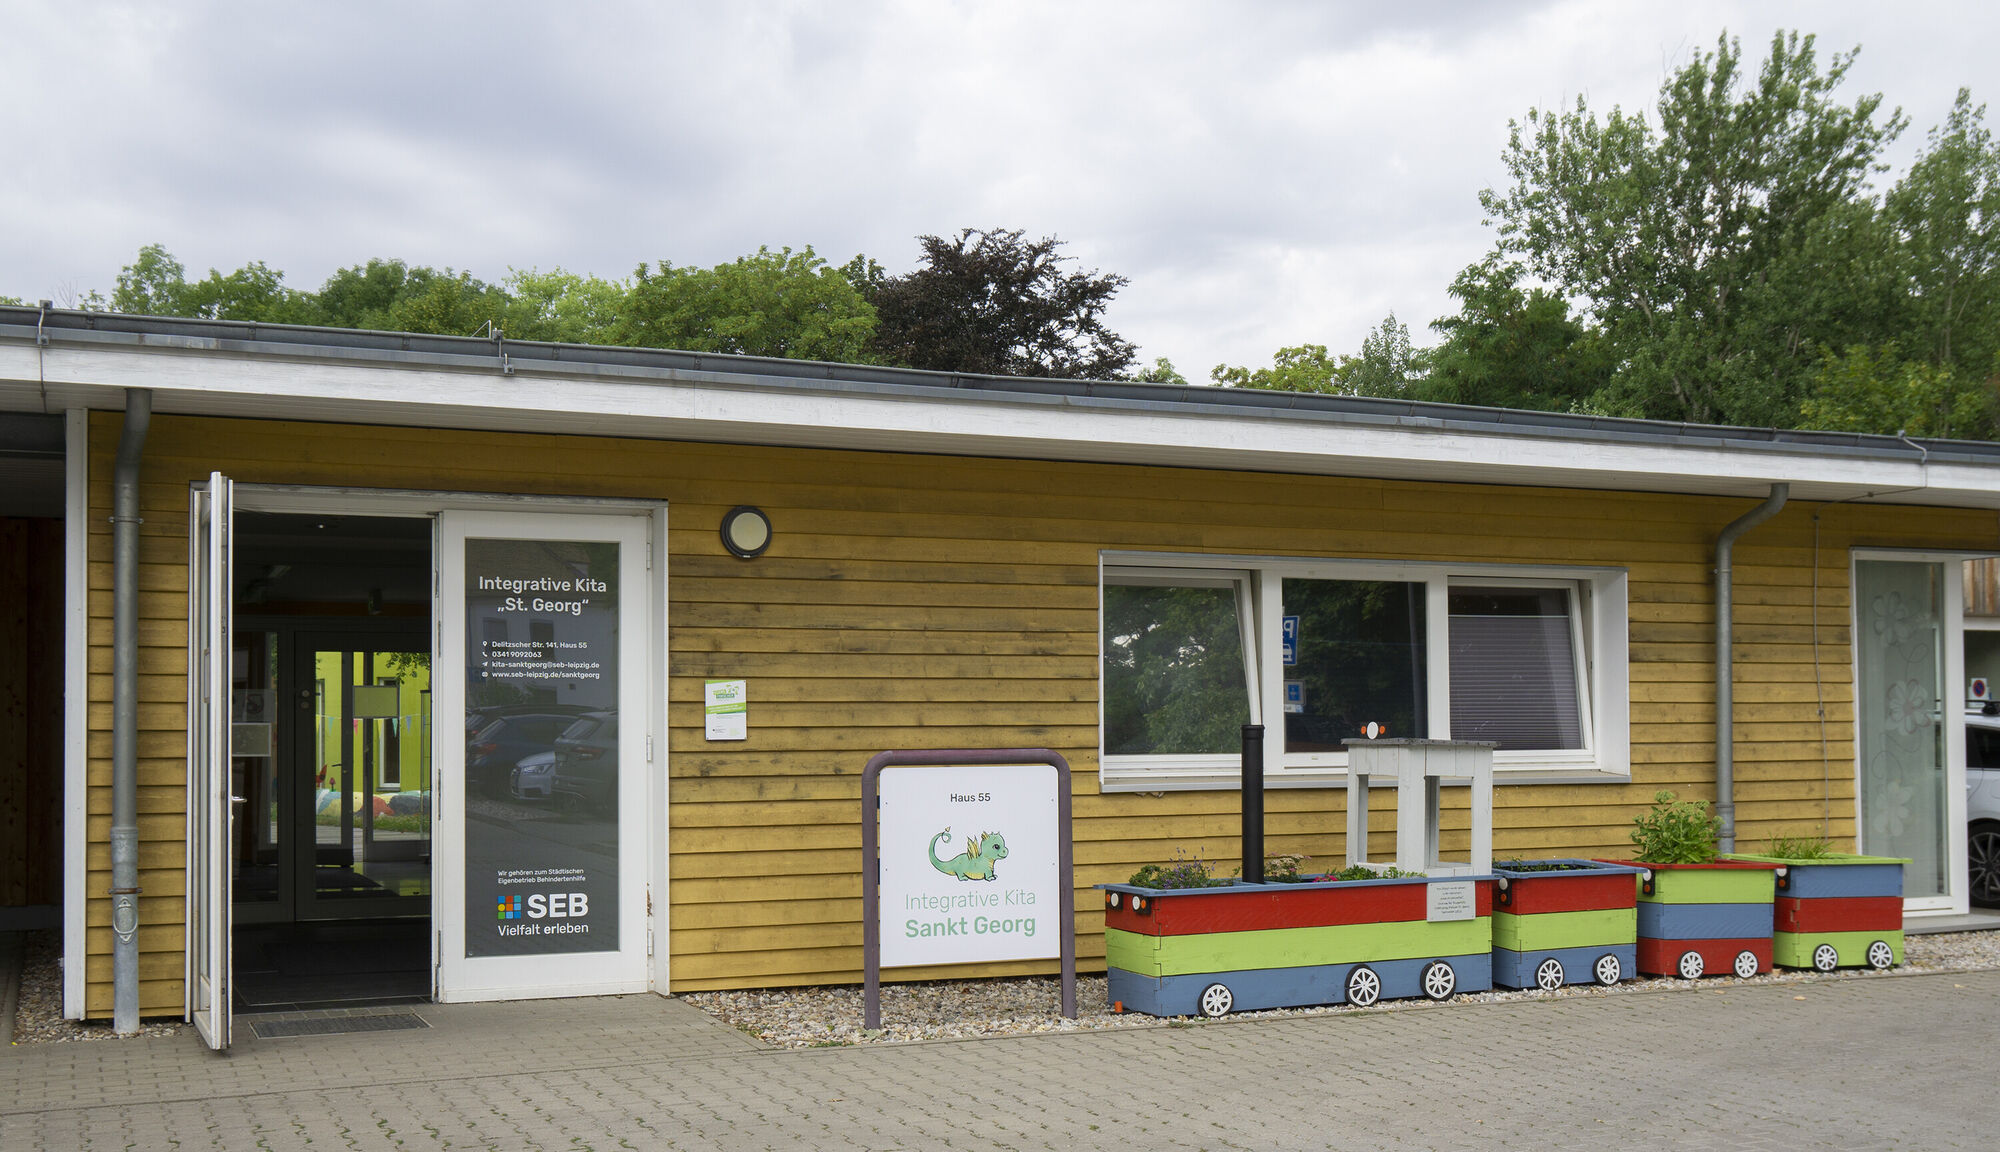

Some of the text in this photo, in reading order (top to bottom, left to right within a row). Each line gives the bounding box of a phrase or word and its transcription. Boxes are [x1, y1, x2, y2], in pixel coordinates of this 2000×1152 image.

[479, 575, 607, 594] Integrative Kita
[497, 597, 589, 615] „St. Georg“
[492, 671, 600, 680] www.seb-leipzig.de/sanktgeorg
[950, 793, 991, 802] Haus 55
[527, 893, 588, 918] SEB
[905, 889, 1036, 913] Integrative Kita
[498, 922, 589, 936] Vielfalt erleben
[905, 916, 1036, 938] Sankt Georg
